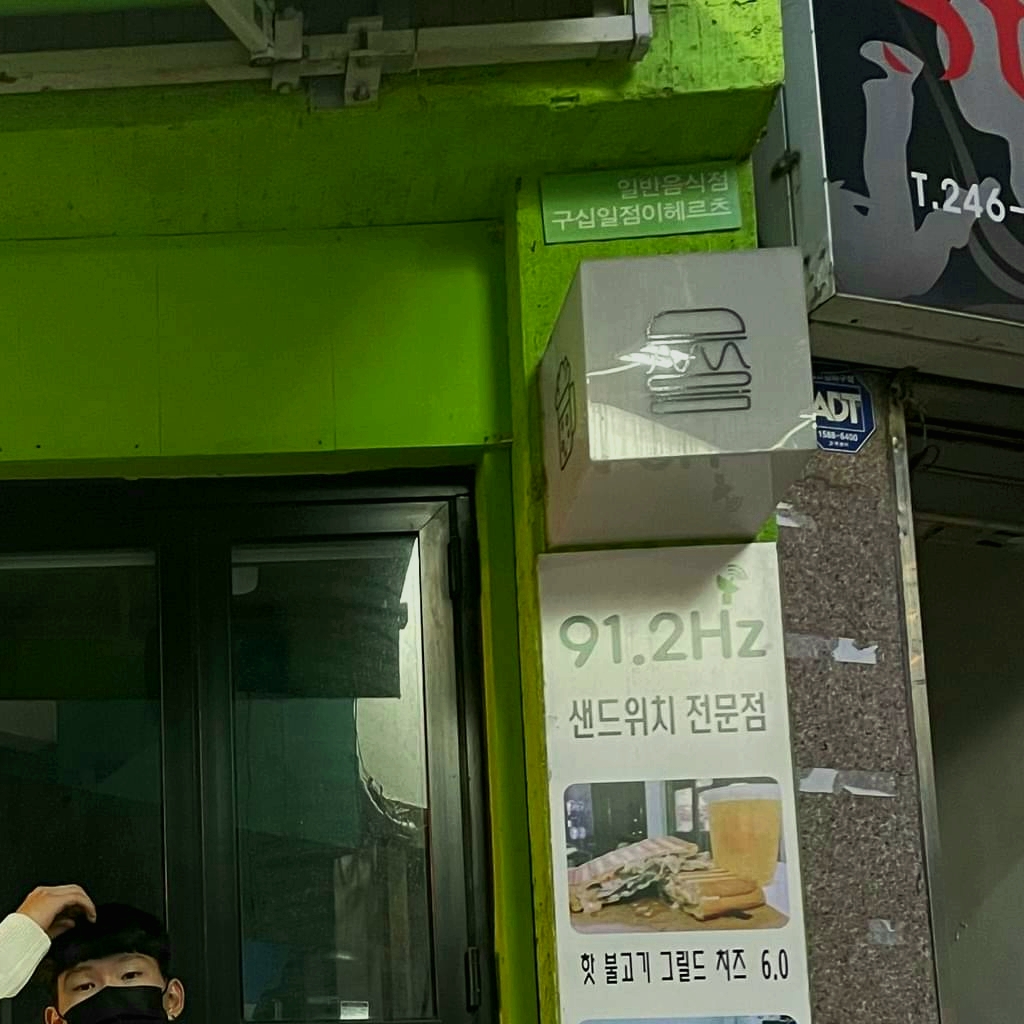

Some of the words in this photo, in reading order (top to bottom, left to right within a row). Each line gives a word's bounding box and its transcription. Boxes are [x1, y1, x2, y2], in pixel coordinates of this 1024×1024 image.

[617, 171, 729, 200] 일반음식점
[552, 197, 732, 231] 구십일점이헤르츠
[814, 391, 862, 424] ADT
[559, 609, 767, 668] 91.2Hz
[569, 695, 676, 739] 샌드위치
[686, 692, 767, 735] 전문점
[580, 952, 596, 985] 핫
[604, 951, 651, 985] 불고기
[660, 950, 706, 983] 그릴드
[716, 949, 747, 981] 치즈
[761, 949, 789, 981] 6.0
